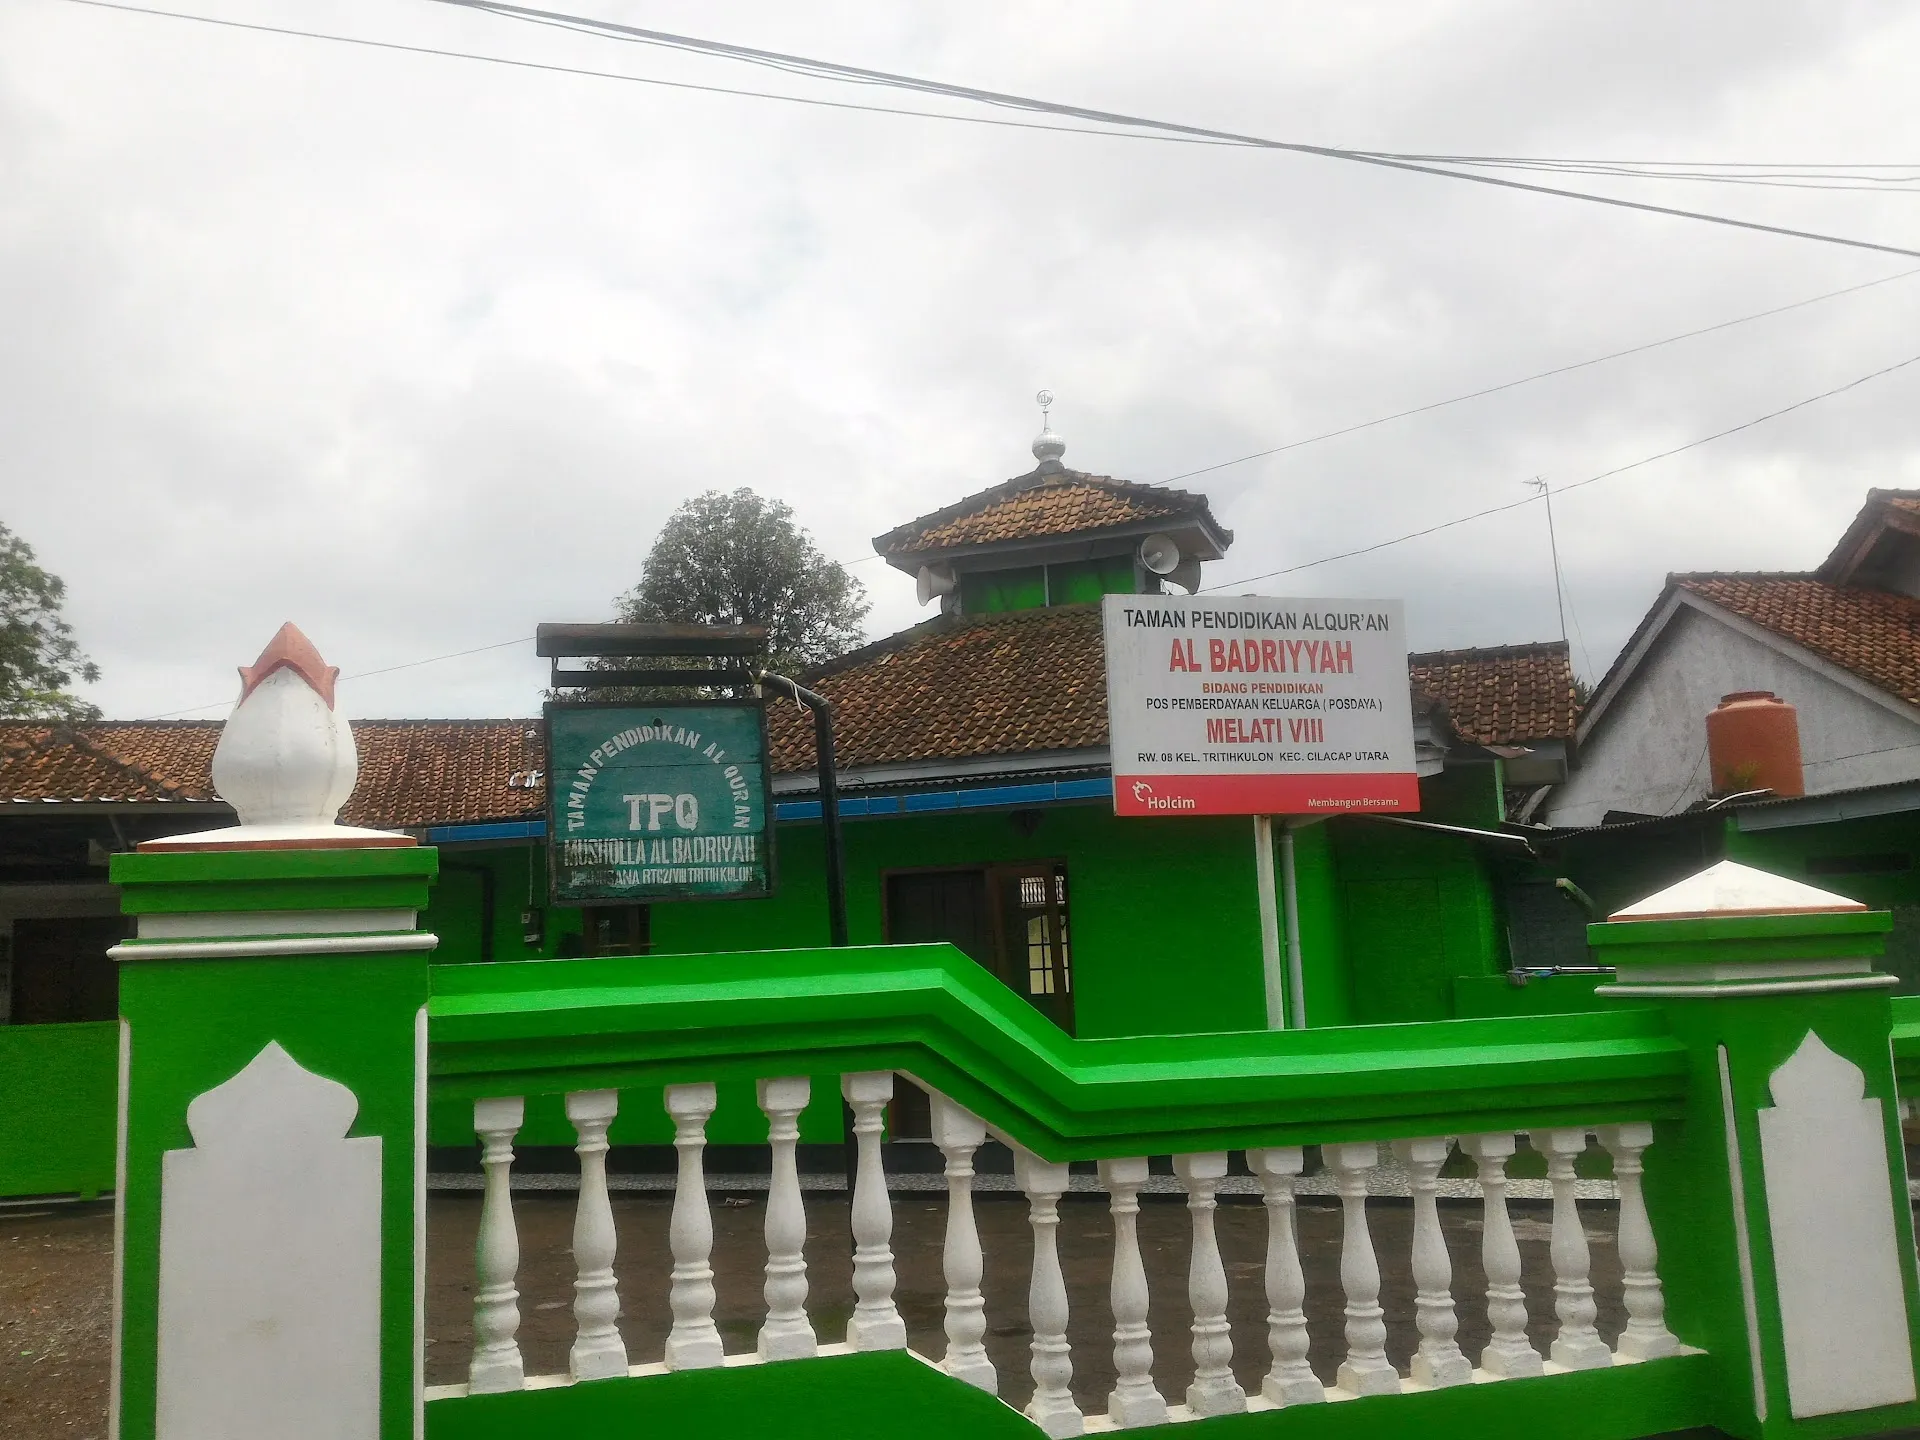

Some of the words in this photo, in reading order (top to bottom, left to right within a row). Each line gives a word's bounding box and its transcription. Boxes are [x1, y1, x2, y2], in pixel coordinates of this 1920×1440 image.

[1123, 609, 1186, 628] TAMAN
[1191, 611, 1297, 630] PENDIDIKAN
[1302, 612, 1389, 631] ALQUR'AN
[1169, 638, 1202, 673] AL
[1209, 638, 1354, 674] BADRIYYAH
[1202, 682, 1248, 694] BIDANG
[1251, 683, 1324, 694] PENDIDIKAN
[1146, 698, 1169, 710] POS
[1171, 698, 1260, 710] PEMBERDAYAAN
[1262, 698, 1321, 710] KELUARGA
[1206, 718, 1283, 744] MELATI
[1287, 718, 1324, 743] VIII
[1137, 752, 1158, 762] RW.
[1161, 752, 1173, 762] 08
[1175, 752, 1200, 762] KEL.
[1202, 752, 1274, 762] TRITIHKULON
[1279, 752, 1305, 761] KEC.
[1307, 752, 1352, 761] CILACAP
[1354, 751, 1390, 761] UTARA
[567, 762, 598, 832] TAMAN
[589, 725, 701, 768] PENDIDIKAN
[702, 742, 726, 764] AL
[723, 765, 751, 829] QURAN
[1147, 795, 1196, 809] Holcim
[1308, 798, 1362, 809] Membangun
[1363, 797, 1399, 807] Bersama
[622, 793, 699, 832] TPQ
[564, 838, 646, 867] MUSHOLLA
[650, 838, 670, 864] AL
[672, 835, 756, 864] BADRIYAH
[687, 867, 719, 883] TRITIH
[720, 866, 753, 882] KULON
